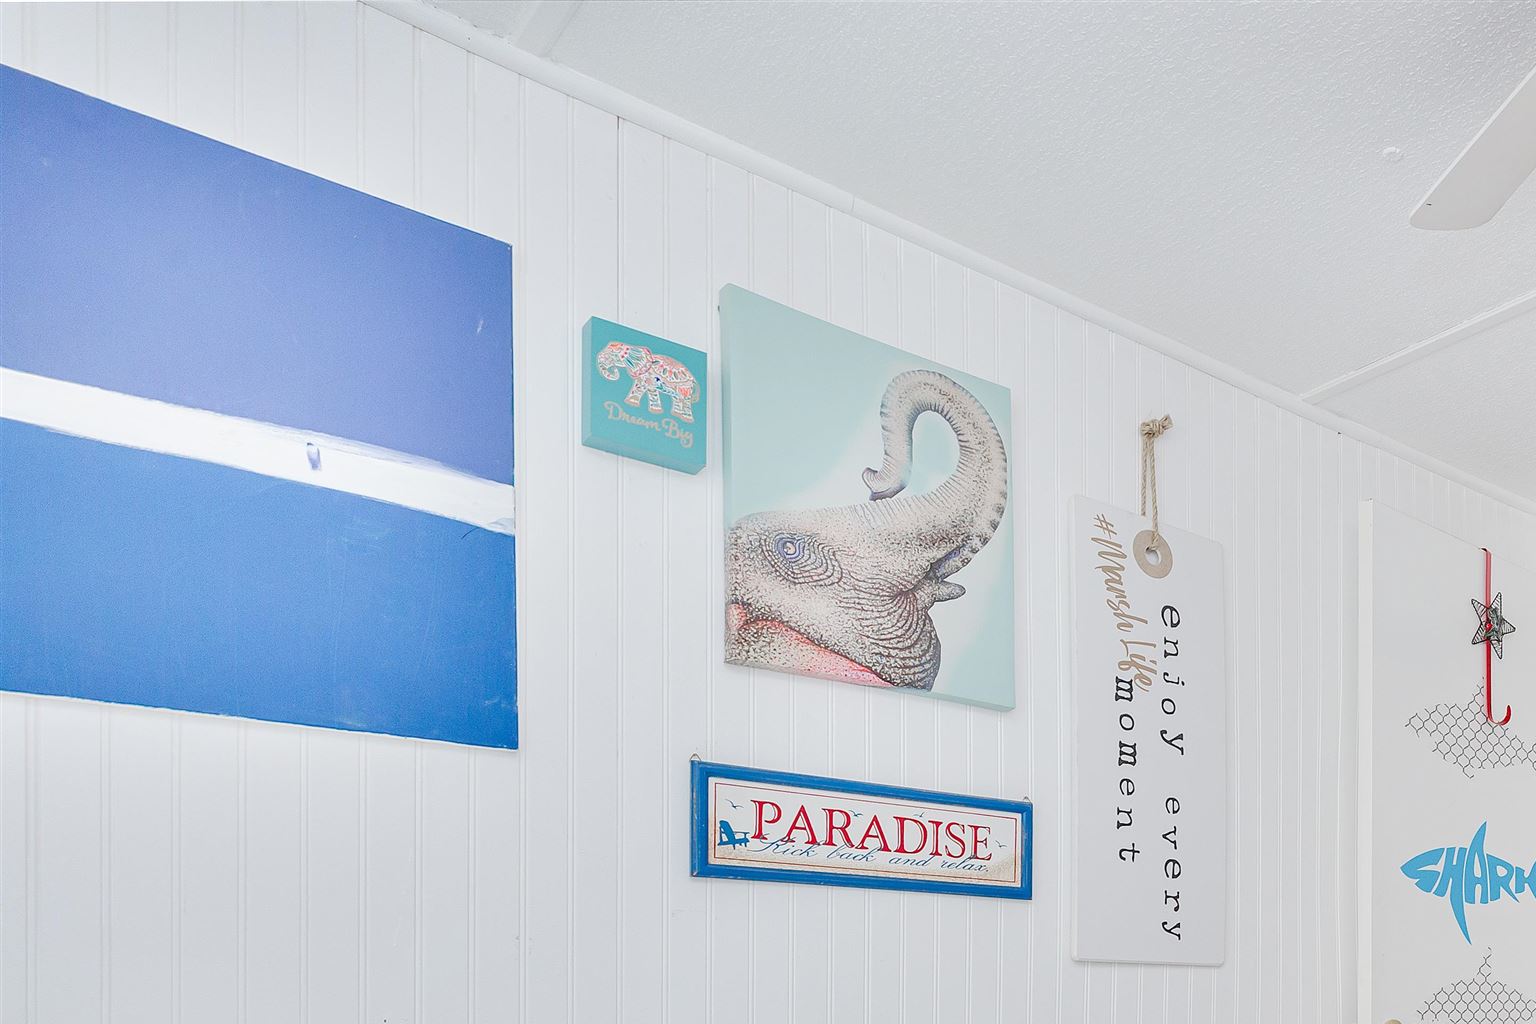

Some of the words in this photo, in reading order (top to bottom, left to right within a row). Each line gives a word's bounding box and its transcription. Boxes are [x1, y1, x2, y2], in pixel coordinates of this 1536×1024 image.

[603, 401, 661, 432] Dream
[661, 418, 695, 449] Big
[1090, 513, 1149, 633] #Marsh
[1118, 638, 1158, 693] Life
[1159, 605, 1185, 756] enjoy
[1114, 676, 1141, 863] moment
[747, 832, 823, 859] Kick
[826, 842, 878, 863] back
[888, 853, 938, 868] and
[750, 799, 993, 861] PARADISE
[1161, 796, 1183, 942] every
